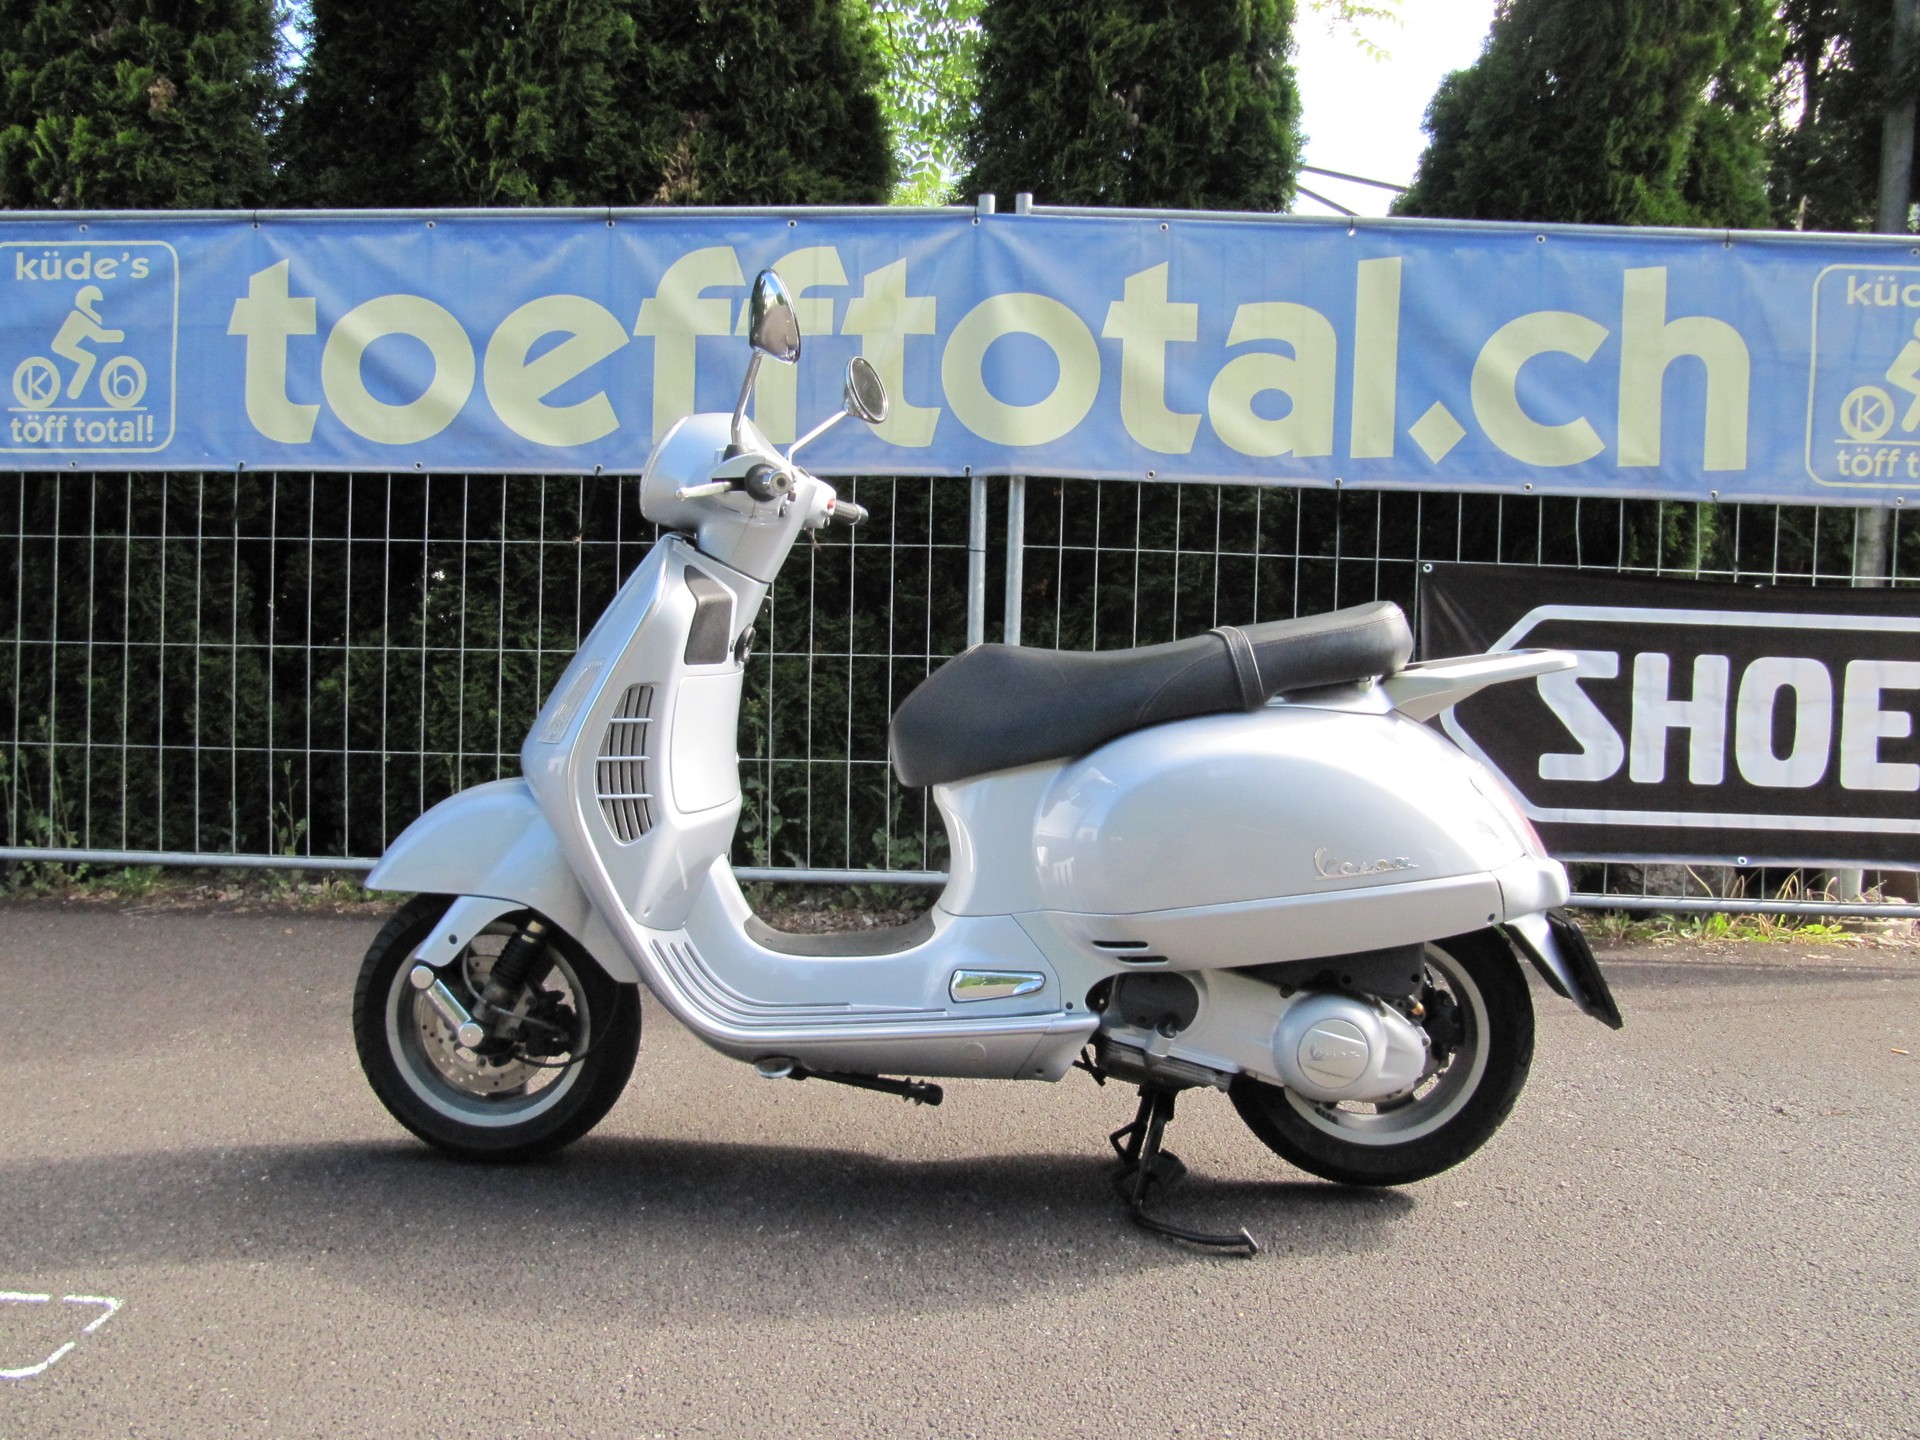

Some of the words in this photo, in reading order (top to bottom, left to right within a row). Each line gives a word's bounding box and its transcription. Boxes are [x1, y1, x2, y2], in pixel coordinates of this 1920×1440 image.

[15, 251, 149, 281] küde's
[227, 246, 1750, 472] toefftotal.ch
[10, 415, 67, 443] töff
[74, 414, 154, 443] total!
[1837, 446, 1901, 477] töff
[1537, 650, 1920, 792] SHOE
